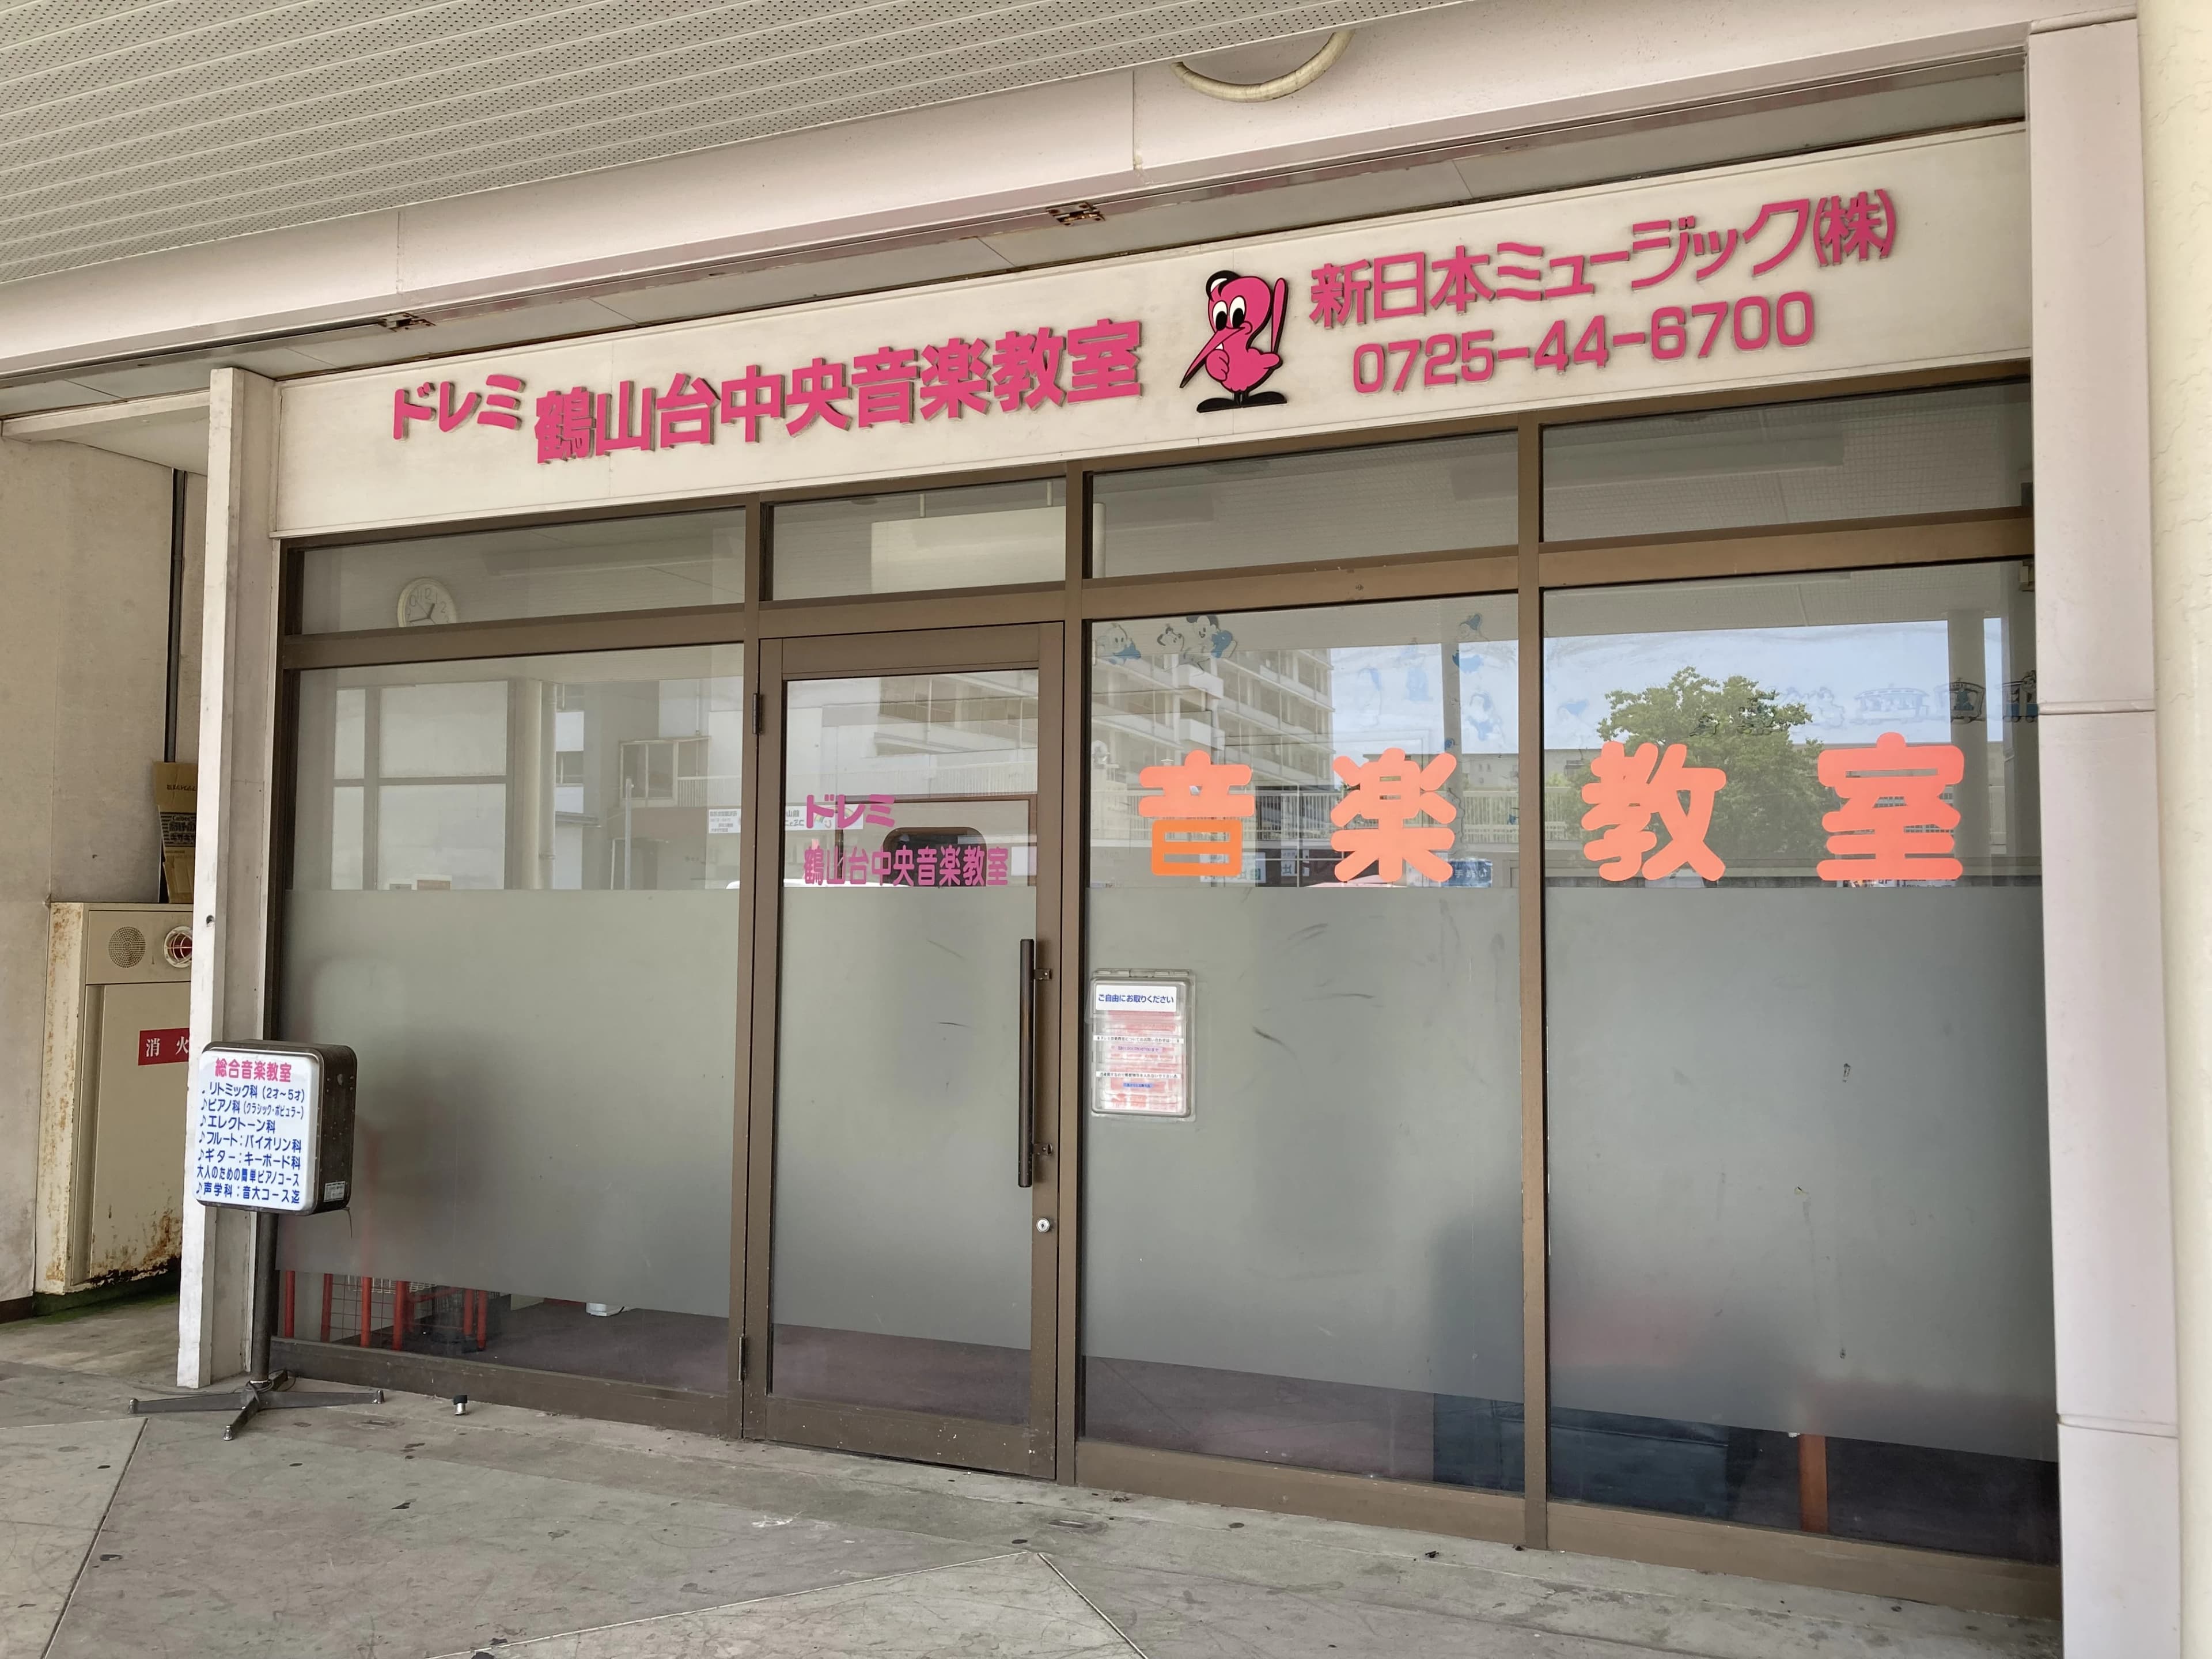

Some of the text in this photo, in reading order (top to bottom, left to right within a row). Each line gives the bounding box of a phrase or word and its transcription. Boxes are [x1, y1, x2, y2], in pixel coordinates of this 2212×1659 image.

[1309, 189, 1896, 328] 新日本ミュージック(株)
[1352, 291, 1814, 393] 0725-44-6700
[393, 319, 1141, 463] ドレミ 鶴山台中央音楽教室
[806, 794, 896, 829] ドレミ
[1139, 733, 1964, 883] 音楽教室
[805, 844, 1009, 887] 鶴山台中央音楽教室
[1098, 994, 1174, 1003] ご自由にお取りください
[215, 1058, 291, 1082] 総合音楽教室
[208, 1098, 240, 1114] ピアノ科
[209, 1081, 258, 1099] リトミック科
[208, 1115, 275, 1134] エレクトーン科
